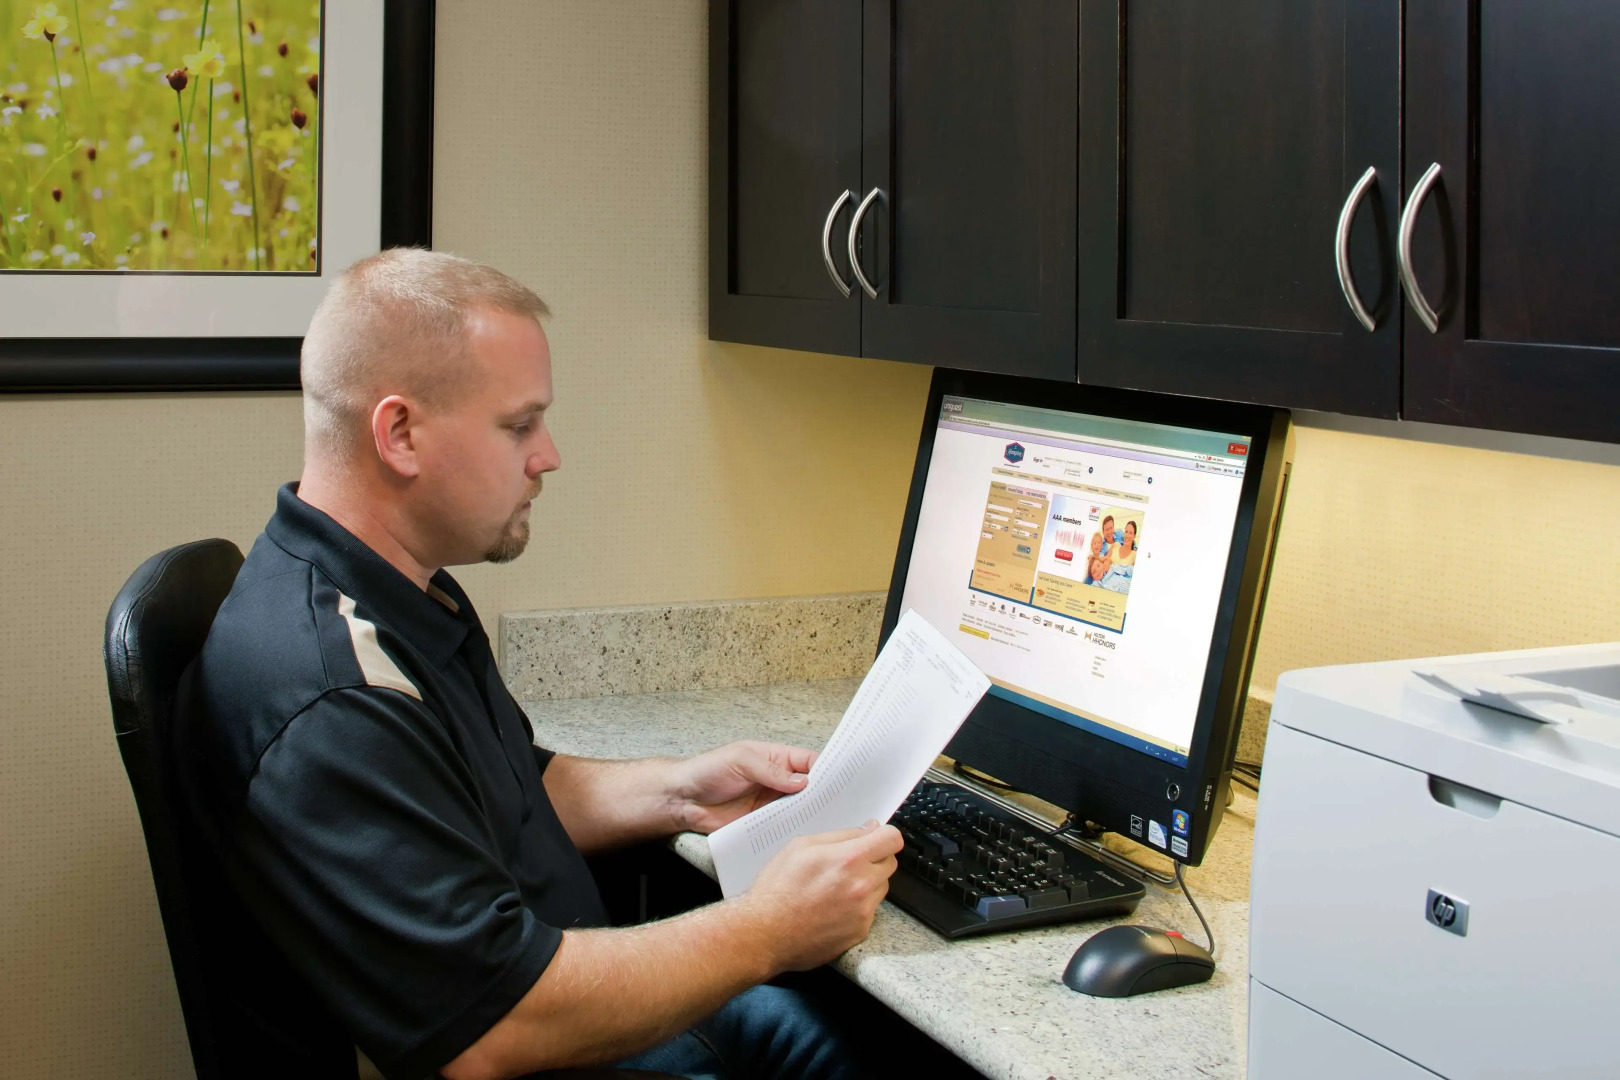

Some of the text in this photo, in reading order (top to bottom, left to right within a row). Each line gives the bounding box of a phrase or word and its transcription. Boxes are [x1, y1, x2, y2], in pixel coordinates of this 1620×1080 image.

[1052, 513, 1062, 521] AAA
[1063, 517, 1082, 526] members
[1433, 894, 1456, 926] hp
